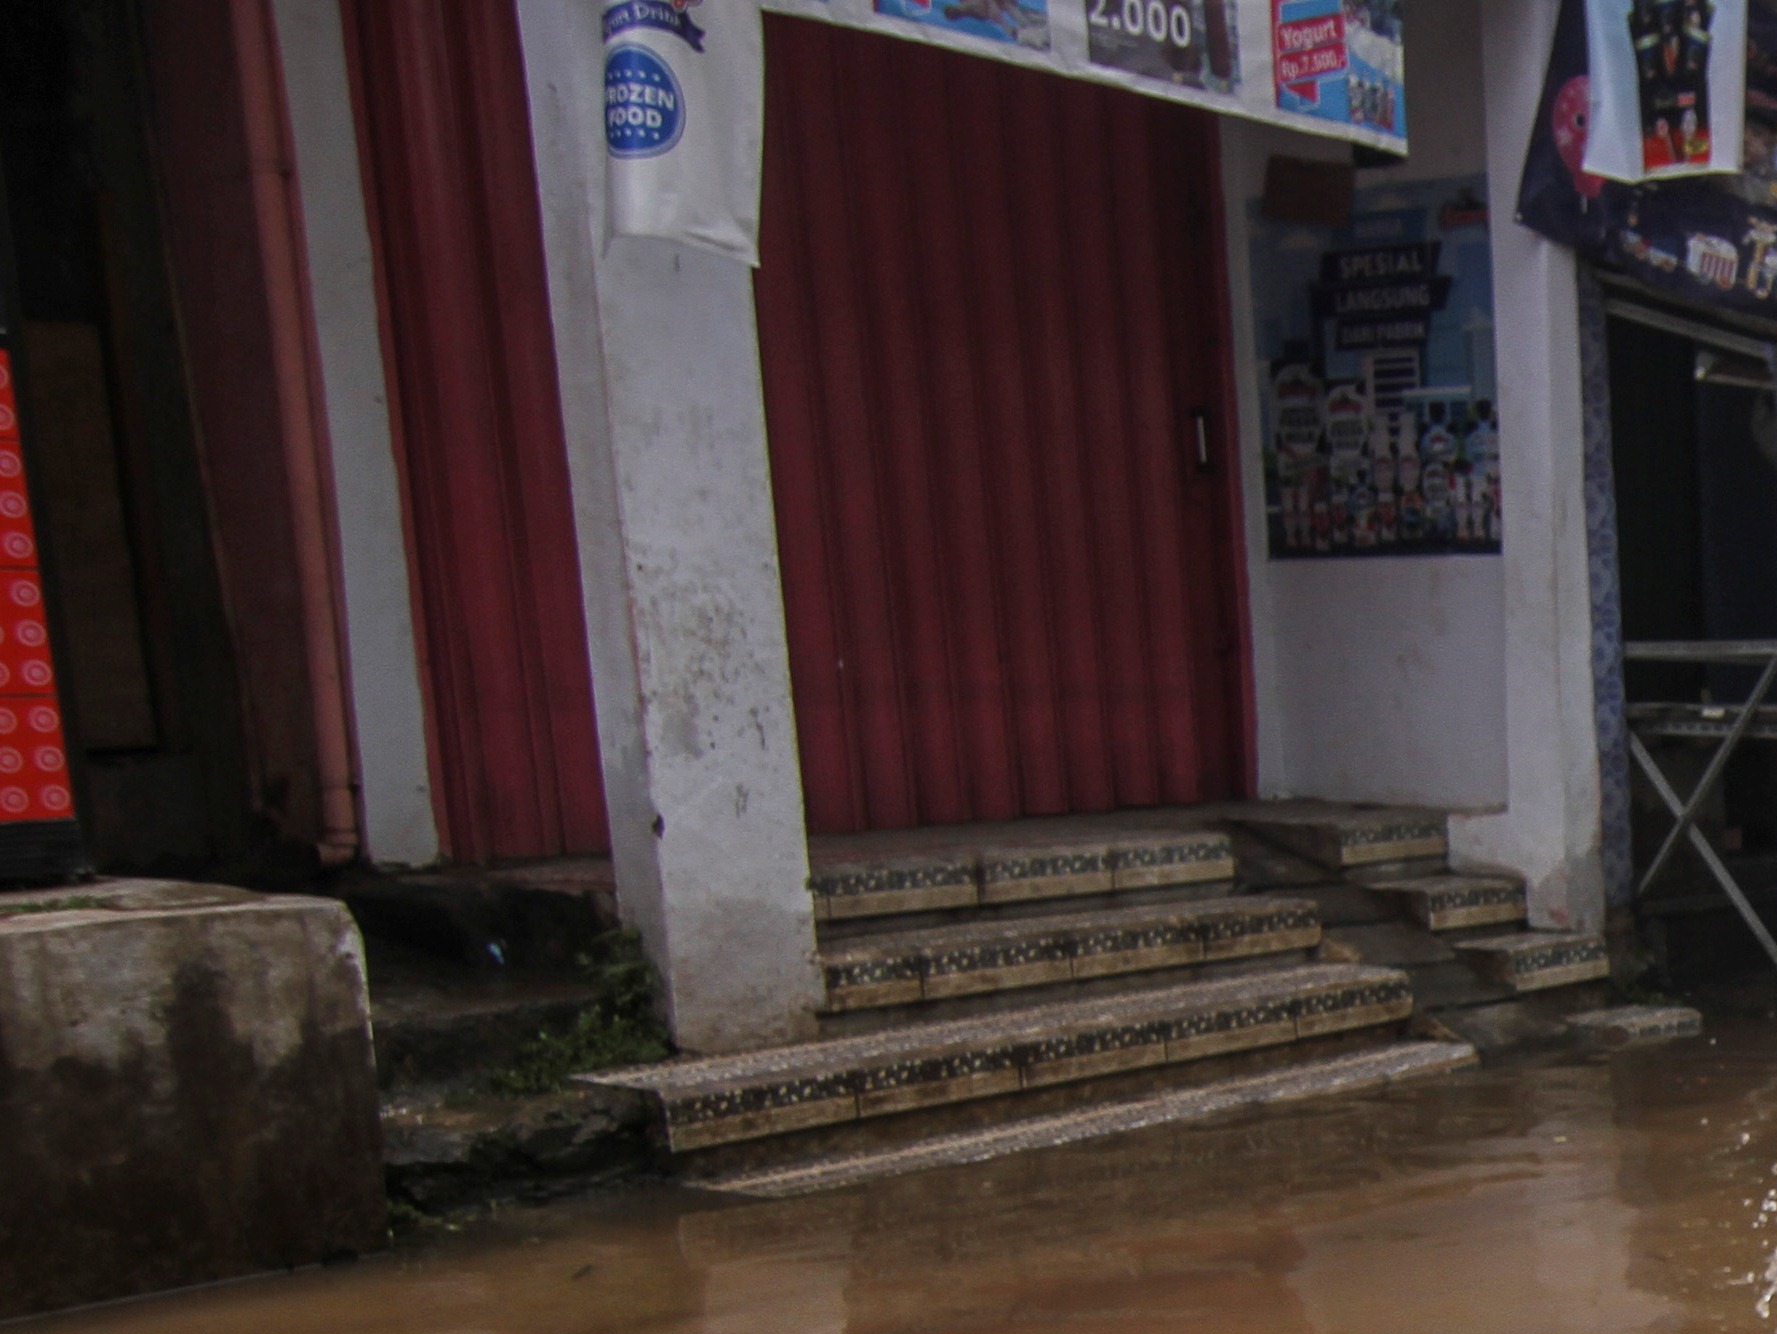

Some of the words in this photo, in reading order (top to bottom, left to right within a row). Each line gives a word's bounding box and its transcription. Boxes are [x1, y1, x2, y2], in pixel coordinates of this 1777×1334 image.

[1089, 0, 1191, 48] 2.000
[1283, 19, 1337, 52] Yogurt
[607, 82, 674, 112] ROZEN
